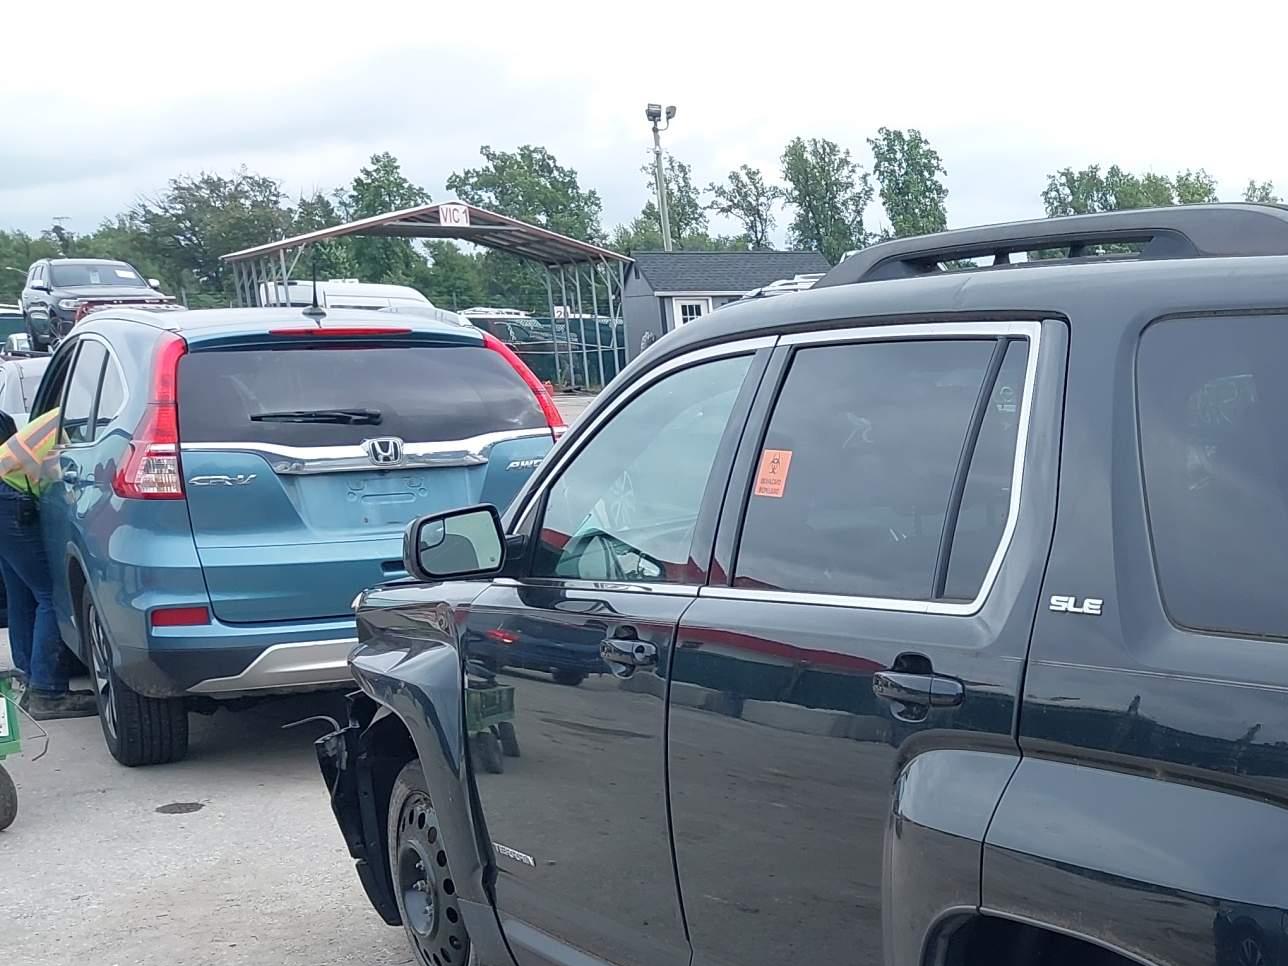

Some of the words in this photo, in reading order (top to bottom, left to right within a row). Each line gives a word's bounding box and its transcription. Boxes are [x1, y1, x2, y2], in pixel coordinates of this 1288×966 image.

[441, 208, 460, 224] VIC
[462, 208, 468, 224] 1
[188, 474, 257, 487] CR-V
[1049, 595, 1104, 616] SLE
